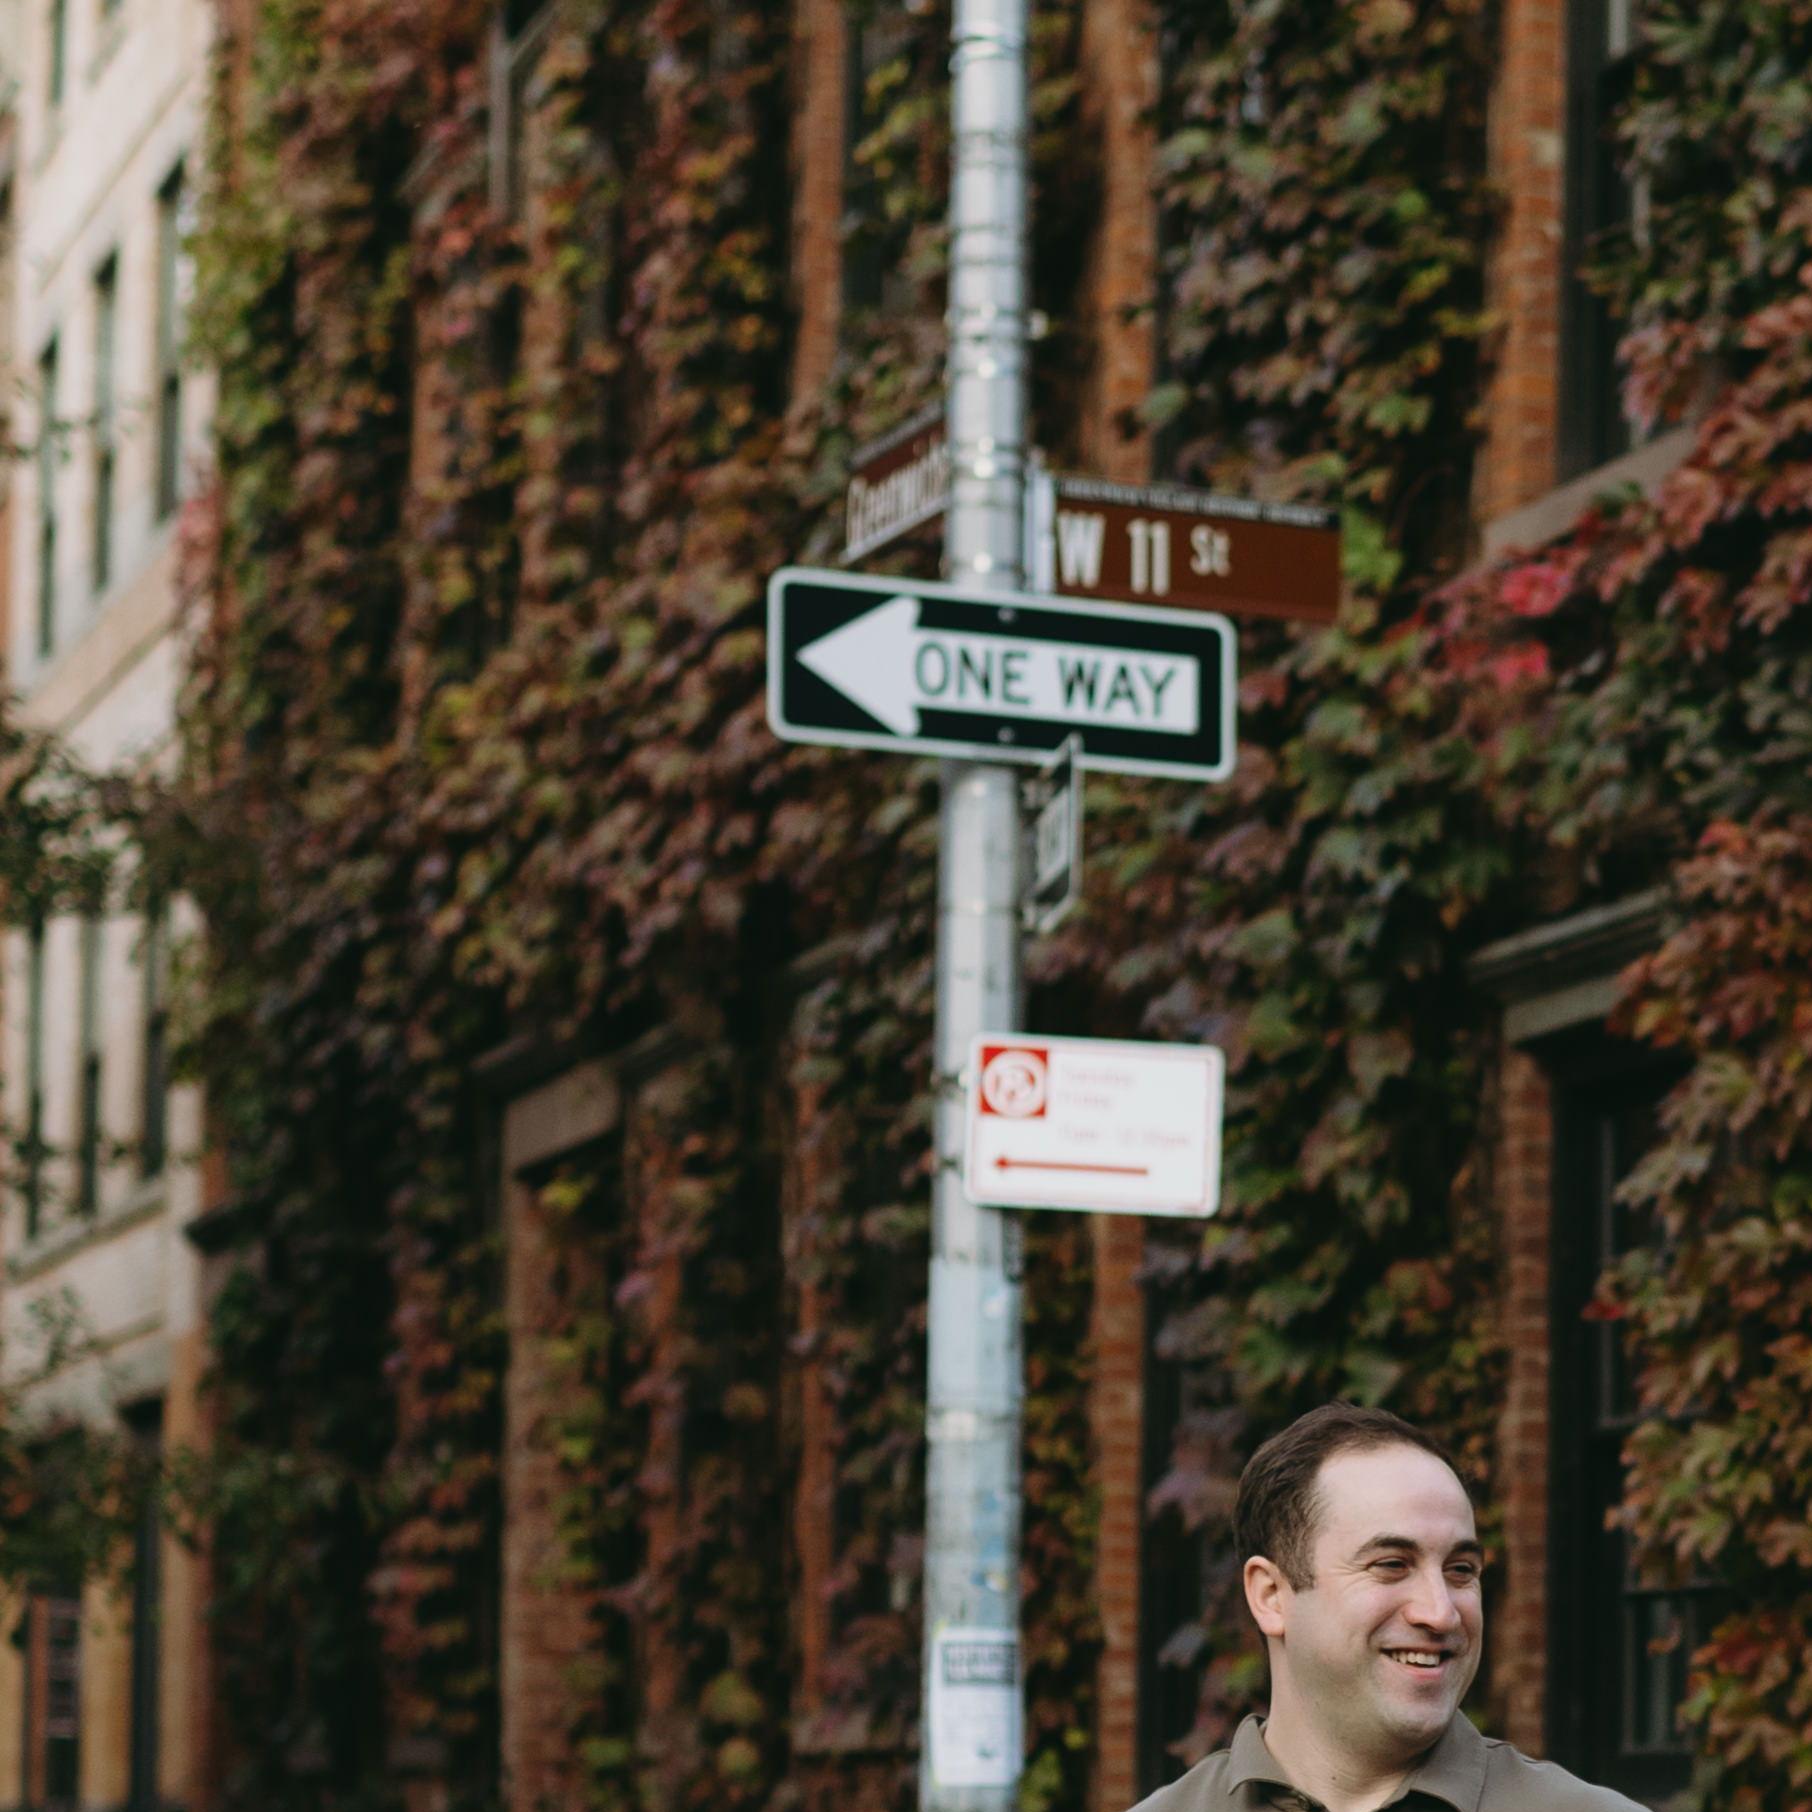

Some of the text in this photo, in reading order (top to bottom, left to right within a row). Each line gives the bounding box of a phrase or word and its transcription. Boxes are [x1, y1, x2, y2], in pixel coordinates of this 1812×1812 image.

[1057, 508, 1232, 597] W 11 St
[914, 640, 1179, 718] ONE WAY
